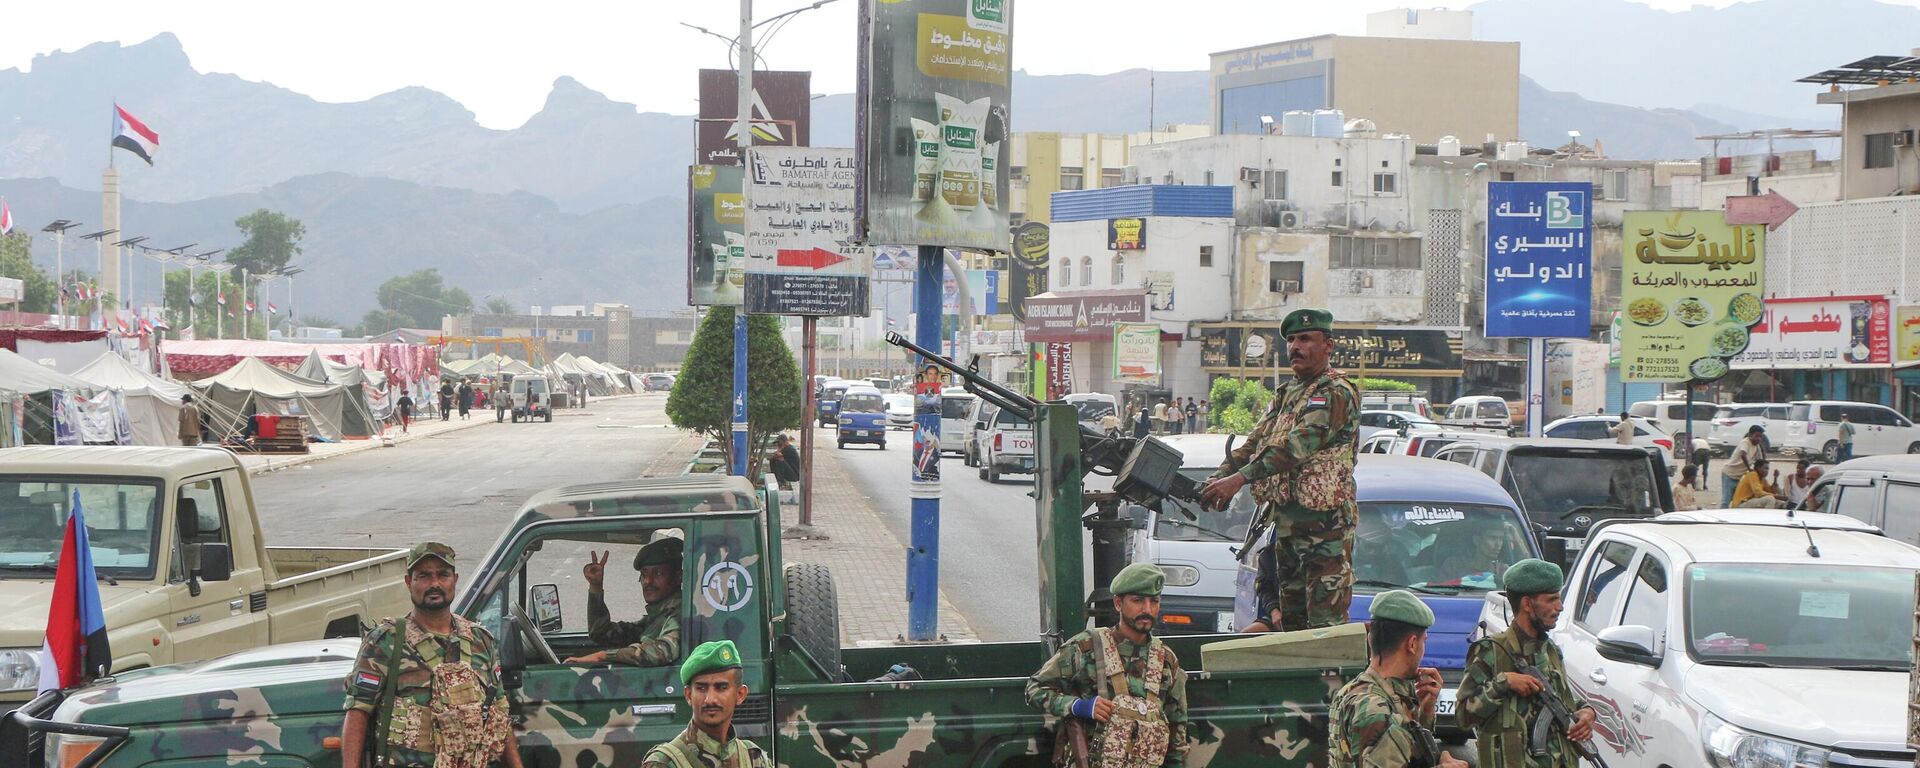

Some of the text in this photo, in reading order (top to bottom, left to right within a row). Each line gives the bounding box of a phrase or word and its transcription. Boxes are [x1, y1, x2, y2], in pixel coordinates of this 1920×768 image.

[930, 29, 1006, 55] دقيق مخلوط
[708, 148, 738, 161] سلامي
[782, 169, 856, 180] BAMATRAF AGEN
[1495, 201, 1542, 221] بنك
[1494, 232, 1584, 254] البسيري
[1494, 262, 1583, 283] الدولي
[1027, 305, 1041, 318] ADEN
[1779, 306, 1841, 342] مطعم
[1062, 362, 1071, 387] ADEN
[1013, 440, 1034, 449] TOY
